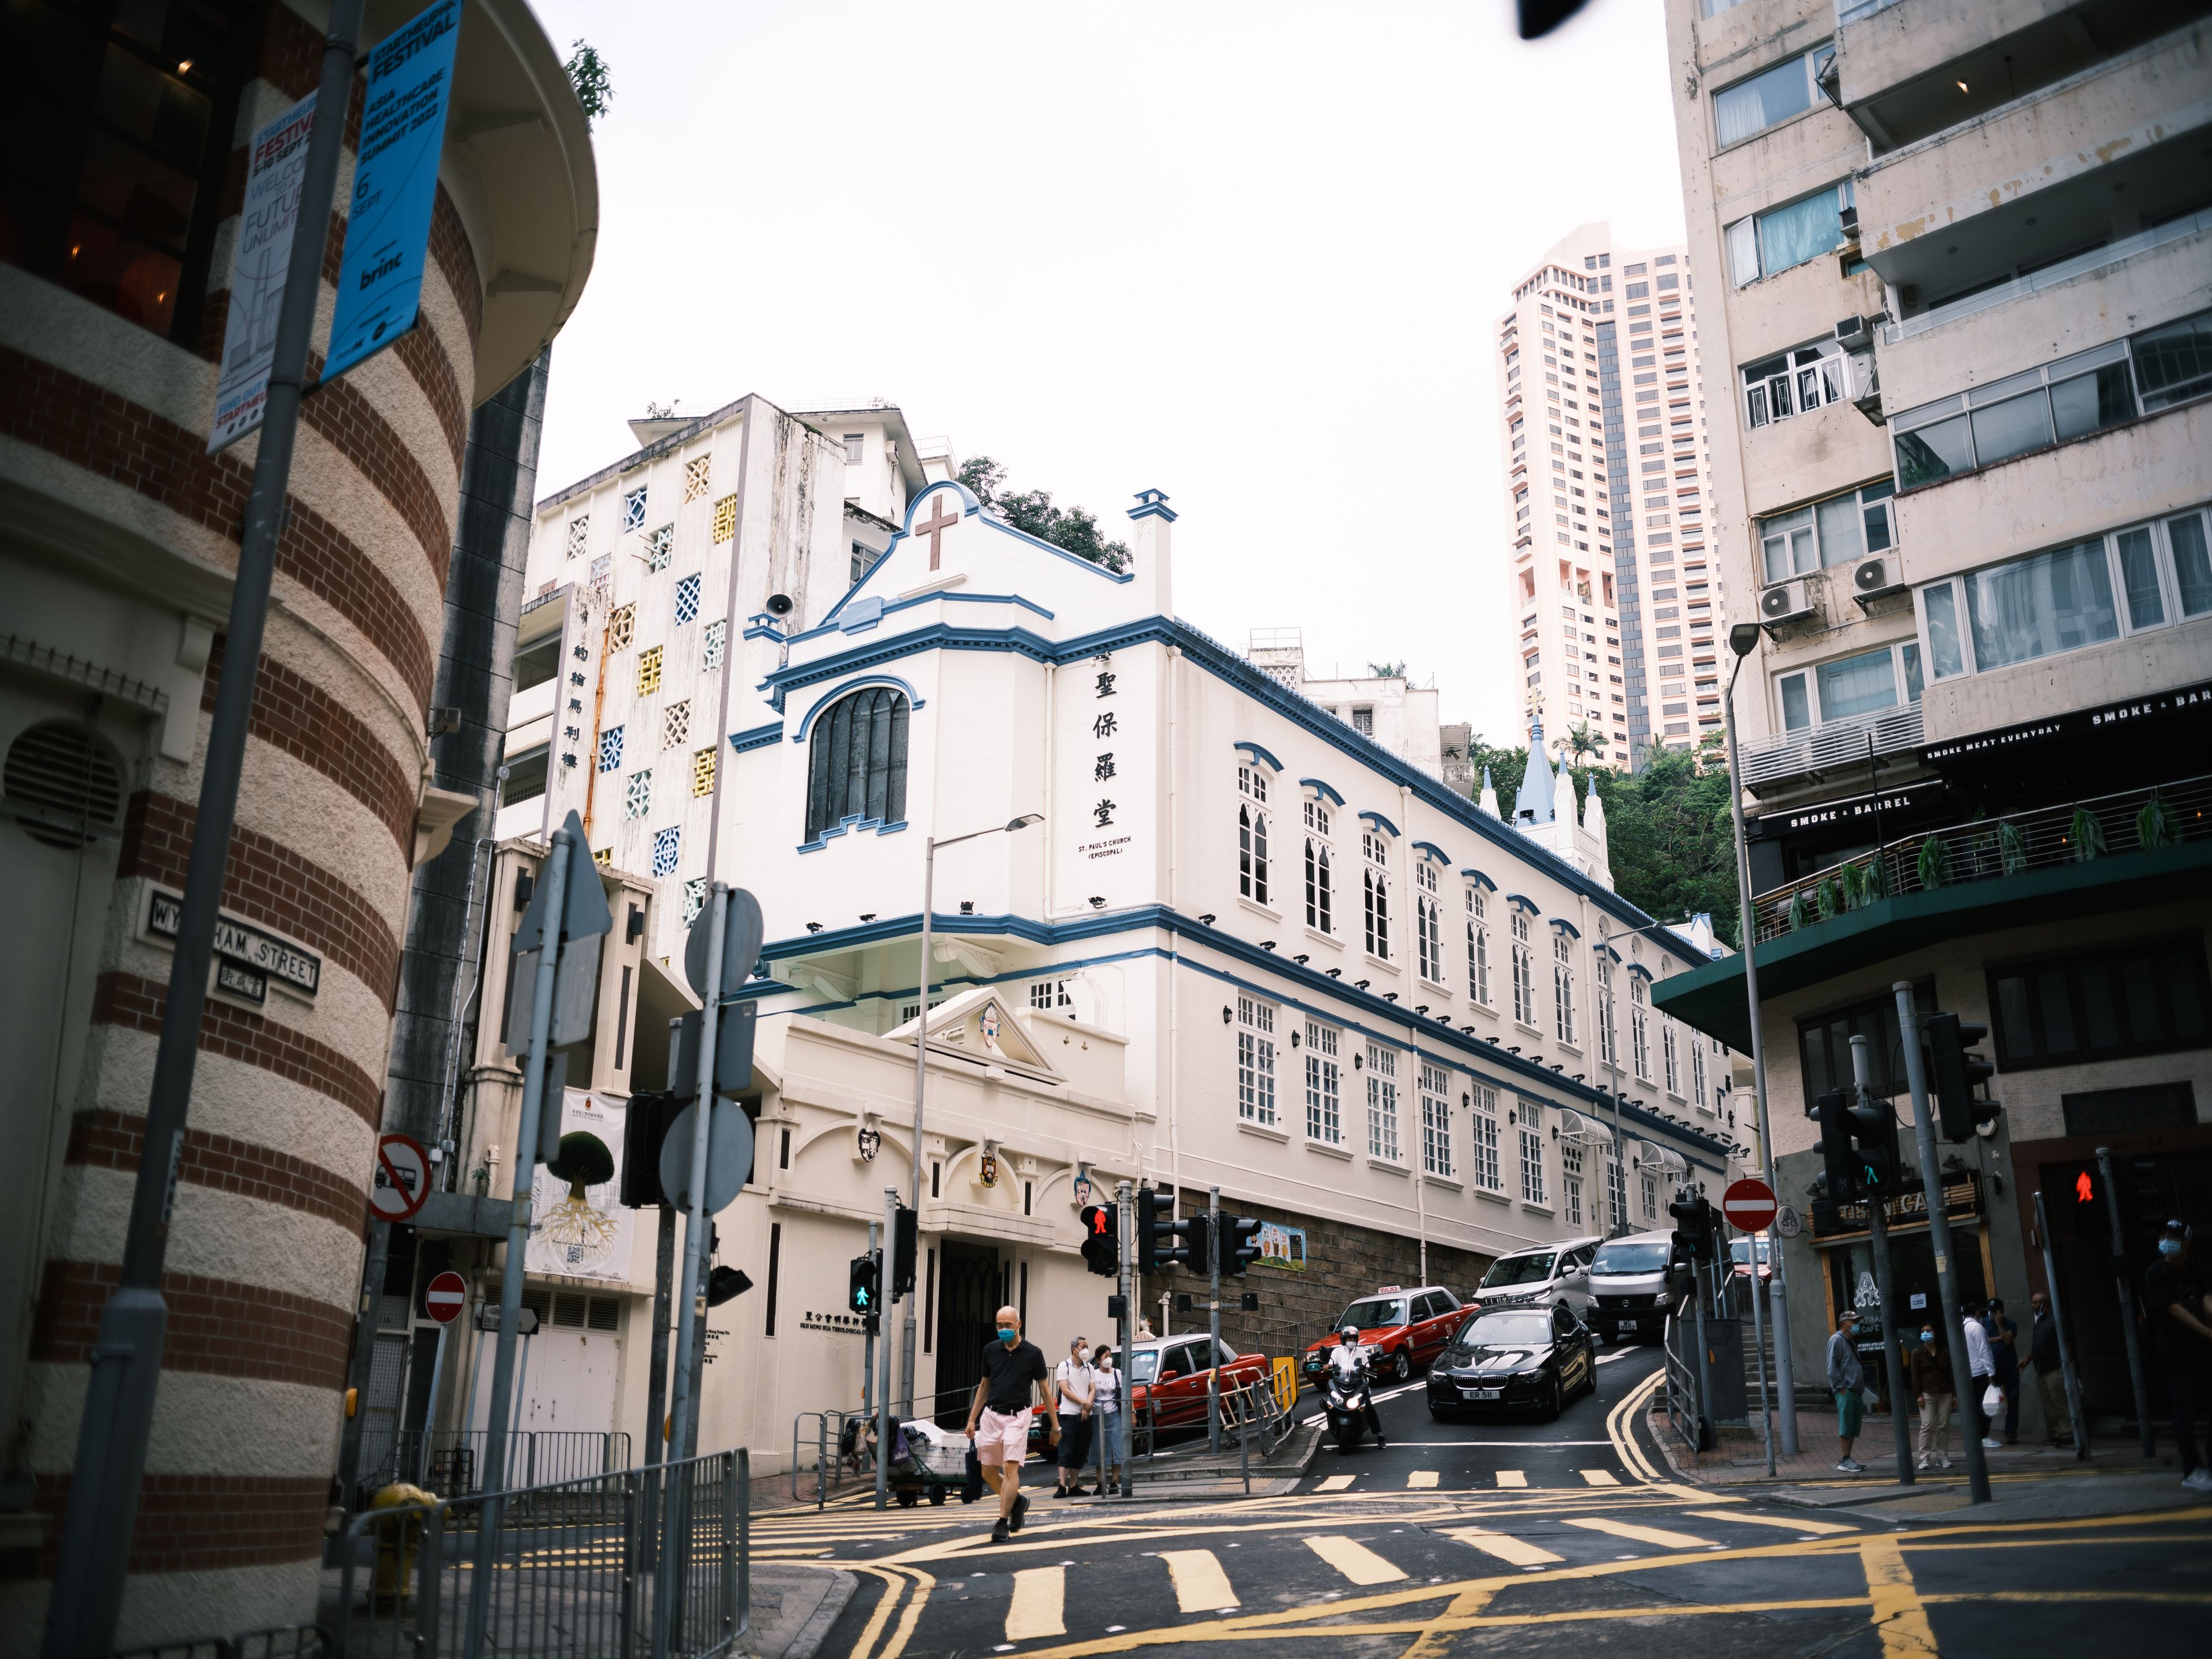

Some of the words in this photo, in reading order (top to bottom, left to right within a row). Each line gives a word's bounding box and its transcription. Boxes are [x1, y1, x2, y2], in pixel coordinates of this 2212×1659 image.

[373, 13, 456, 84] FESTIVAL
[363, 88, 438, 148] INNOVATION
[365, 67, 444, 131] HEALTHCARE
[368, 89, 395, 115] ASIA
[255, 109, 314, 165] FESTIV
[257, 97, 317, 145] STARTMEUP
[360, 124, 408, 166] SUMMIT
[410, 103, 438, 133] 2022
[252, 156, 274, 177] 5-10
[276, 136, 304, 164] SEPT
[251, 156, 306, 200] WELCO
[356, 173, 370, 199] 6
[245, 183, 304, 237] FUTUR
[352, 189, 384, 219] SEPT
[243, 207, 298, 253] UNLIMIT
[359, 252, 403, 291] brinc
[562, 645, 588, 768] 約翰馬利樓
[2092, 703, 2152, 725] SMOKE
[1093, 672, 1118, 828] 聖保羅堂
[1927, 747, 1961, 759] SMOKE
[1967, 739, 1995, 750] MEAT
[2001, 725, 2061, 743] EVERYDAY
[1791, 811, 1836, 827] SMOKE
[1854, 797, 1910, 815] BARREL
[1088, 848, 1123, 859] (EPISCOPAL)
[1089, 842, 1107, 850] PAUL'S
[1109, 836, 1131, 846] CHURCH
[156, 903, 246, 954] WYHAM
[259, 944, 315, 983] STREET
[1854, 1271, 1880, 1308] A
[832, 1326, 861, 1335] THEOLOGICAL
